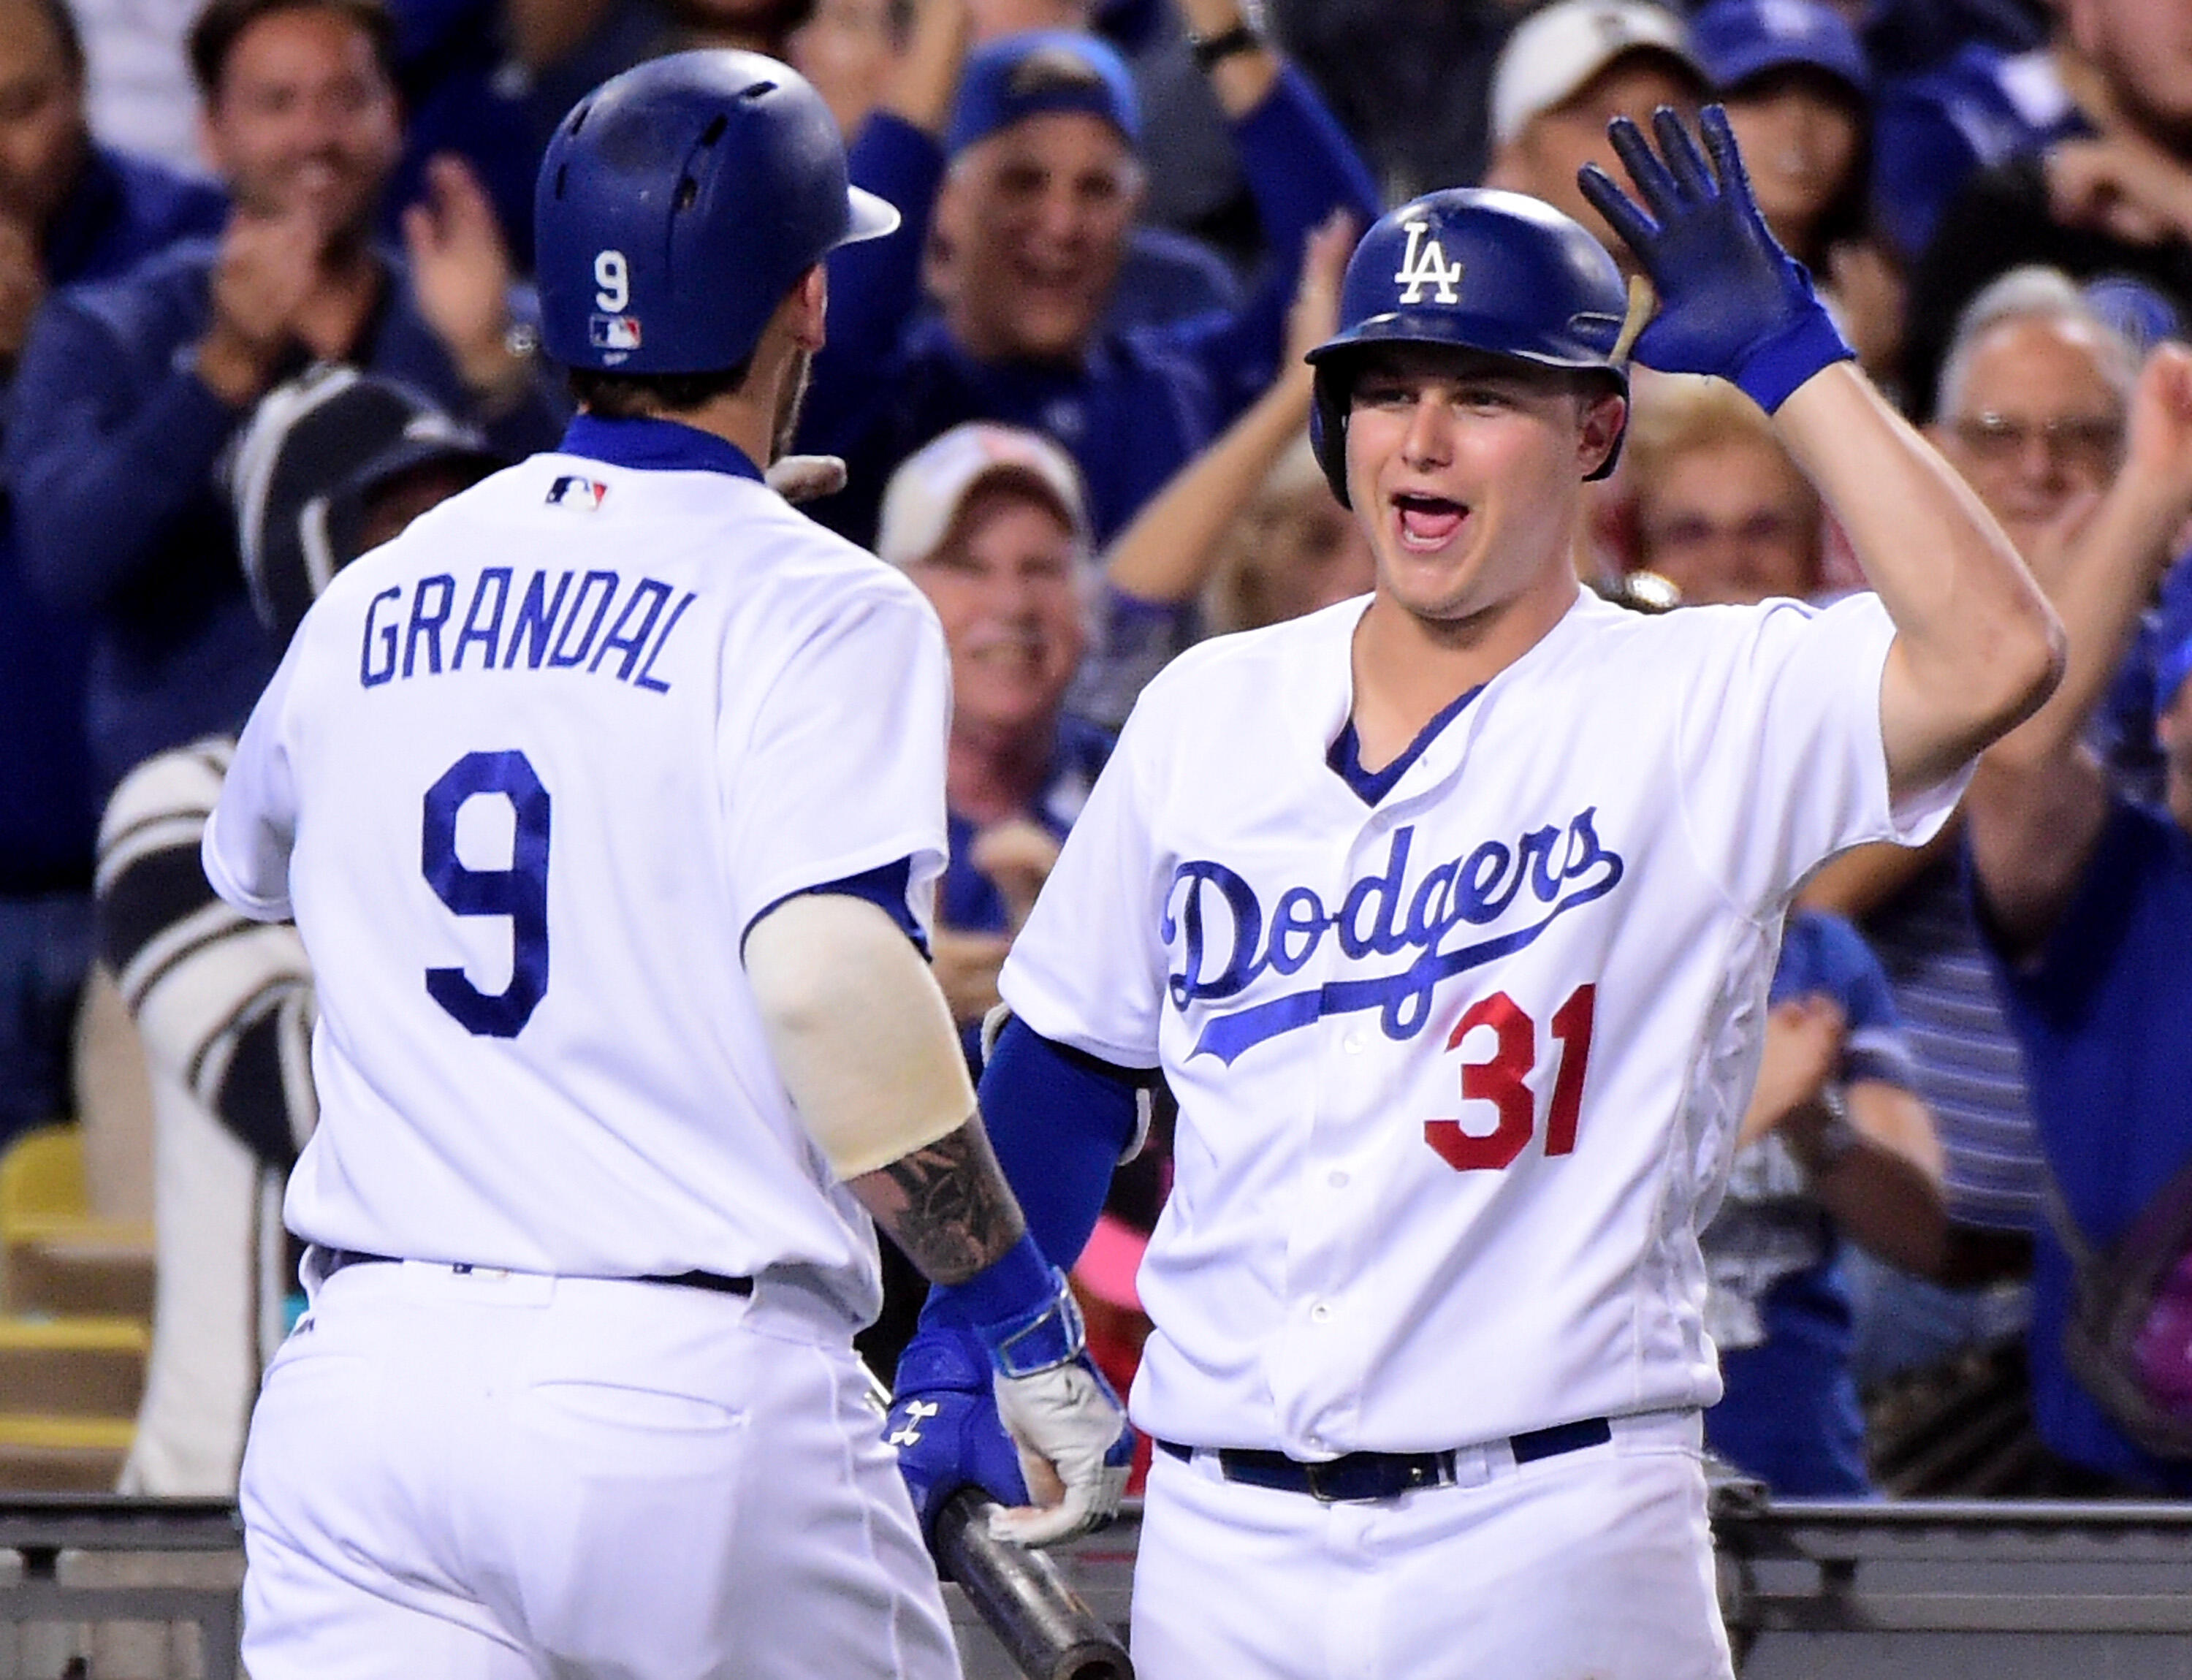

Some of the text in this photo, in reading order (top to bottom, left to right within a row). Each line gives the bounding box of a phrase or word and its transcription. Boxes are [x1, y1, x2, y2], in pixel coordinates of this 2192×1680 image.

[594, 249, 629, 313] 9
[1394, 221, 1462, 304] LA
[360, 566, 698, 695] GRANDAL
[422, 748, 552, 1040] 9
[1160, 805, 1624, 1041] Dodgers
[1423, 982, 1597, 1172] 31
